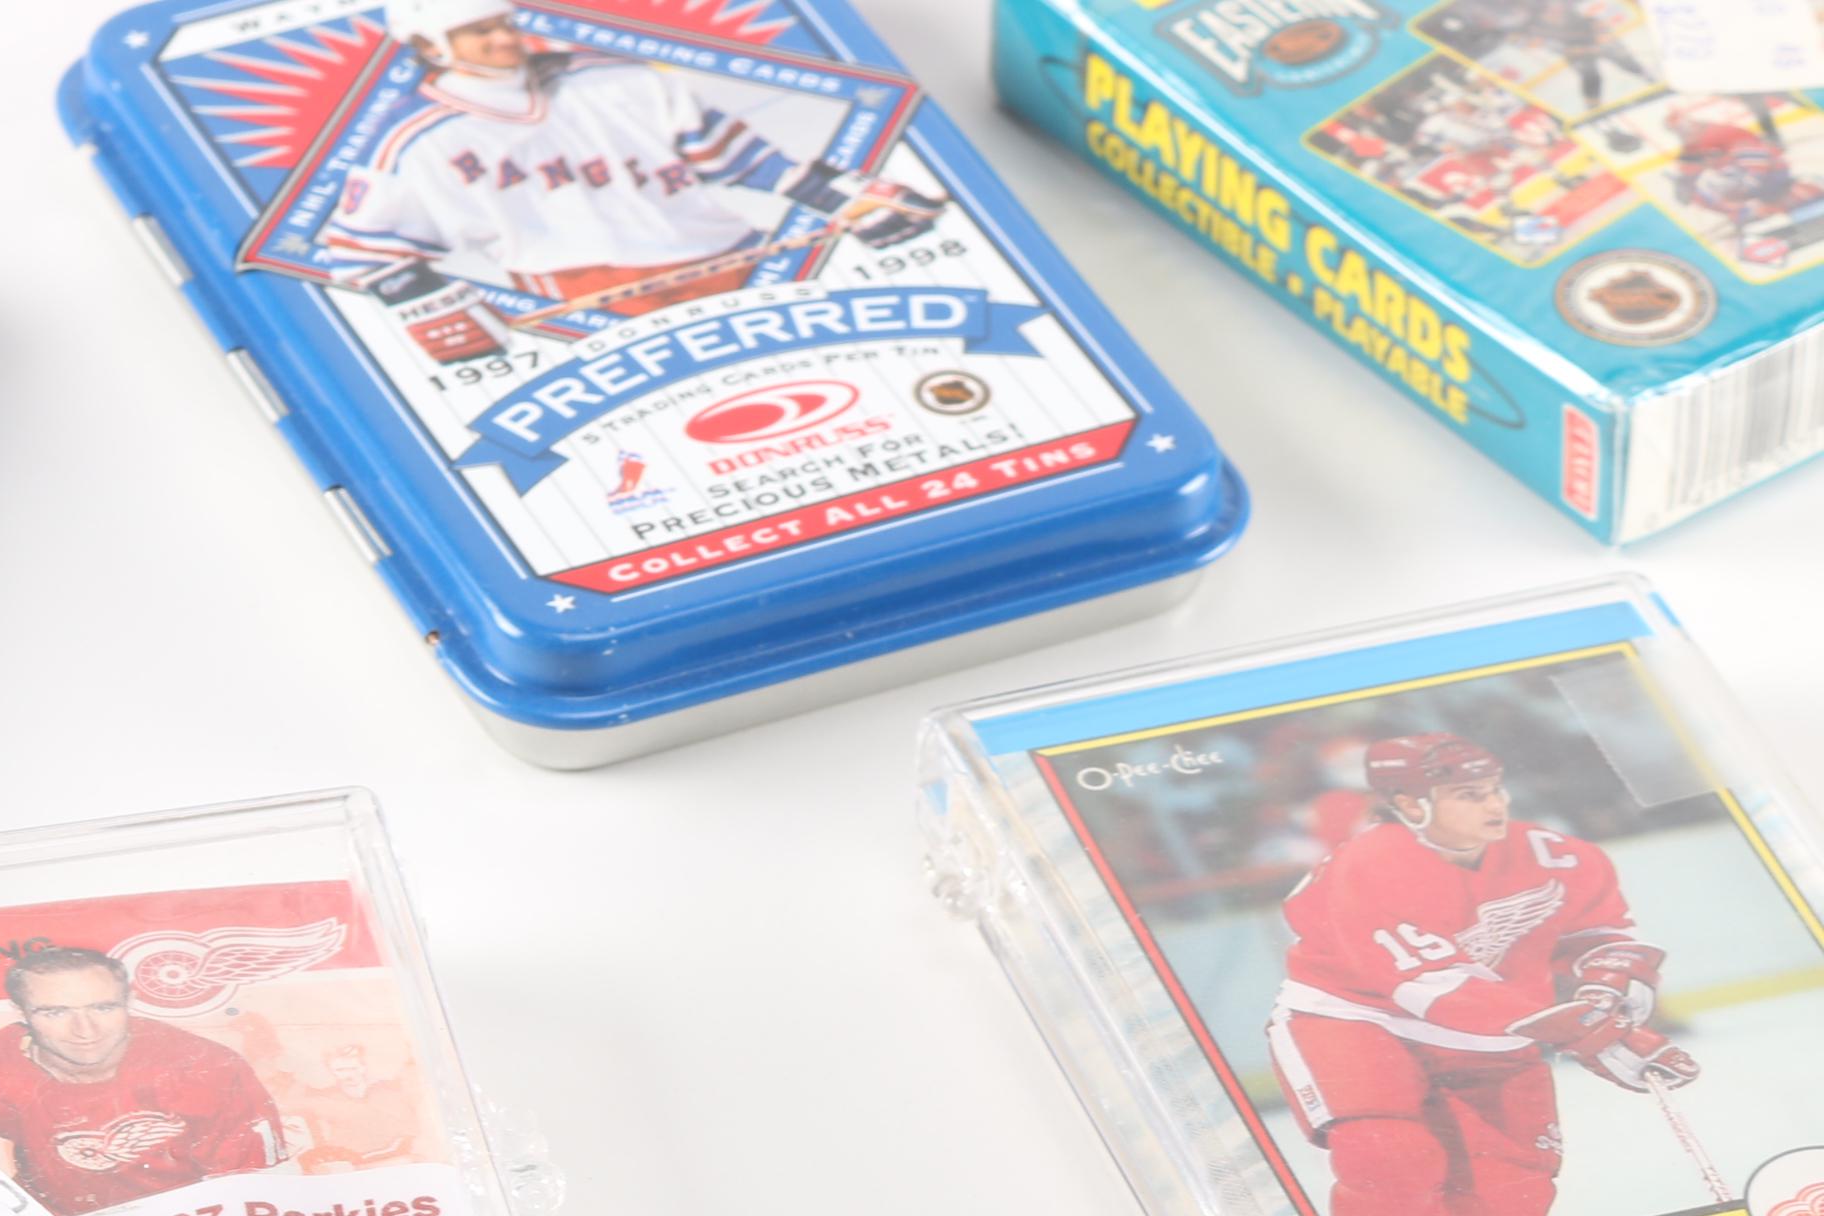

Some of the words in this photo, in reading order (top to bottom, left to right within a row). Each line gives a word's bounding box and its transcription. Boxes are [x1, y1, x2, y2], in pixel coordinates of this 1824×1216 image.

[581, 21, 718, 68] TRADING
[727, 59, 843, 93] CARDS
[289, 180, 338, 229] NHL
[1084, 52, 1293, 254] PLAYING
[1306, 226, 1472, 383] CARDS
[853, 239, 967, 281] 1998
[1086, 120, 1278, 284] COLLECTIBLE
[1312, 286, 1470, 425] PLAYABLE
[589, 285, 813, 351] DONRUSS
[427, 350, 543, 392] 1997
[491, 293, 968, 445] PREFERRED
[603, 382, 713, 433] TRADING
[720, 358, 813, 388] CARDS
[824, 350, 879, 366] PER
[706, 455, 846, 500] SEARCH
[861, 433, 924, 460] FOR
[707, 416, 893, 477] DONRUSS
[607, 519, 804, 583] COLLECT
[825, 495, 909, 527] ALL
[920, 472, 980, 500] 24
[991, 442, 1097, 480] TINS
[631, 476, 836, 541] PRECIOUS
[848, 424, 1025, 483] METALS!
[1526, 829, 1578, 868] C
